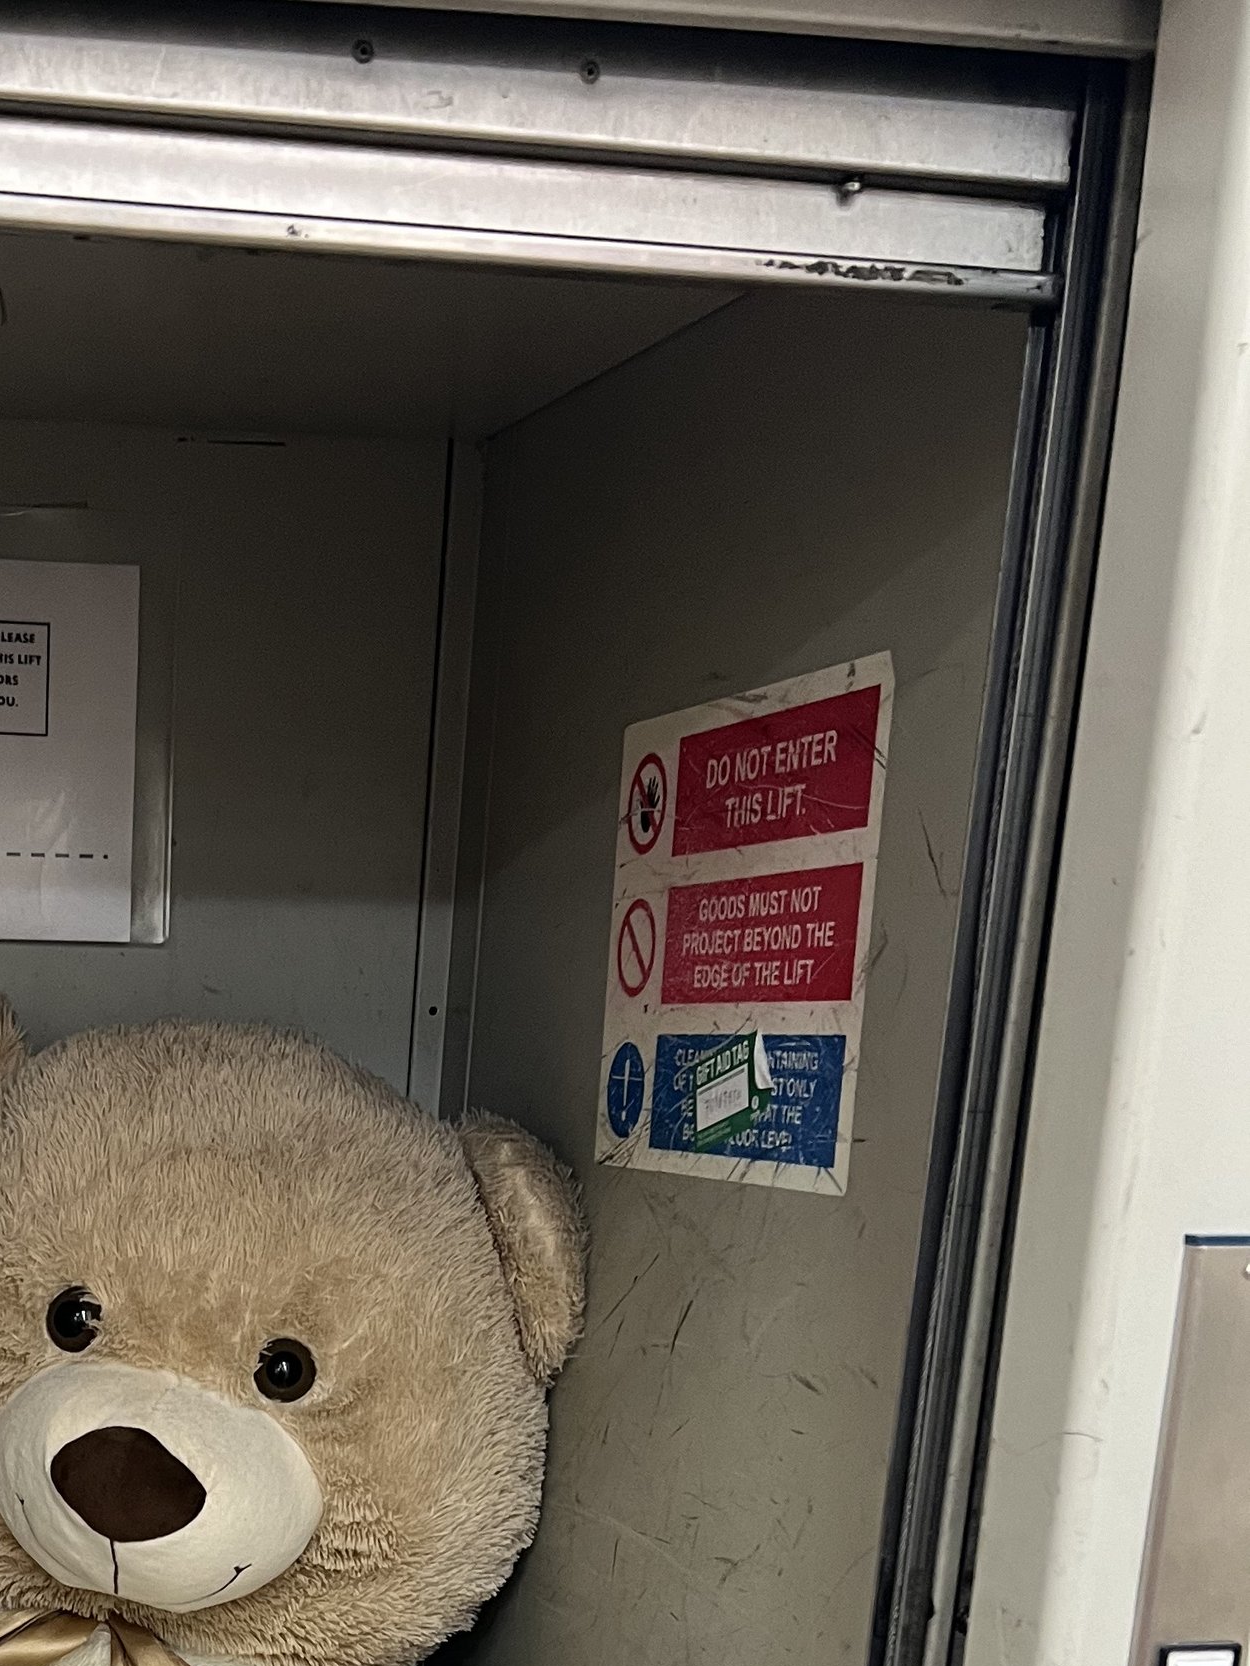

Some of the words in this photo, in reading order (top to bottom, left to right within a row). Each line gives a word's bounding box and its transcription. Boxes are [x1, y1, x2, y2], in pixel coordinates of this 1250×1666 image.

[18, 654, 42, 666] LIFT
[706, 754, 731, 789] DO
[735, 745, 772, 783] NOT
[775, 729, 838, 774] ENTER
[725, 792, 763, 829] THIS
[766, 783, 806, 822] LIFT.
[699, 894, 746, 922] GOODS
[749, 889, 788, 917] MUST
[790, 886, 823, 913] NOT
[682, 929, 741, 956] PROJECT
[743, 924, 802, 953] BEYOND
[806, 921, 836, 948] THE
[693, 963, 729, 989] EDGE
[732, 962, 750, 988] OF
[754, 960, 781, 986] THE
[783, 959, 815, 985] LIFT
[696, 1057, 715, 1086] GIFT
[715, 1049, 732, 1076] AID
[731, 1040, 750, 1065] TAG
[786, 1078, 817, 1098] ONLY
[781, 1104, 802, 1124] THE
